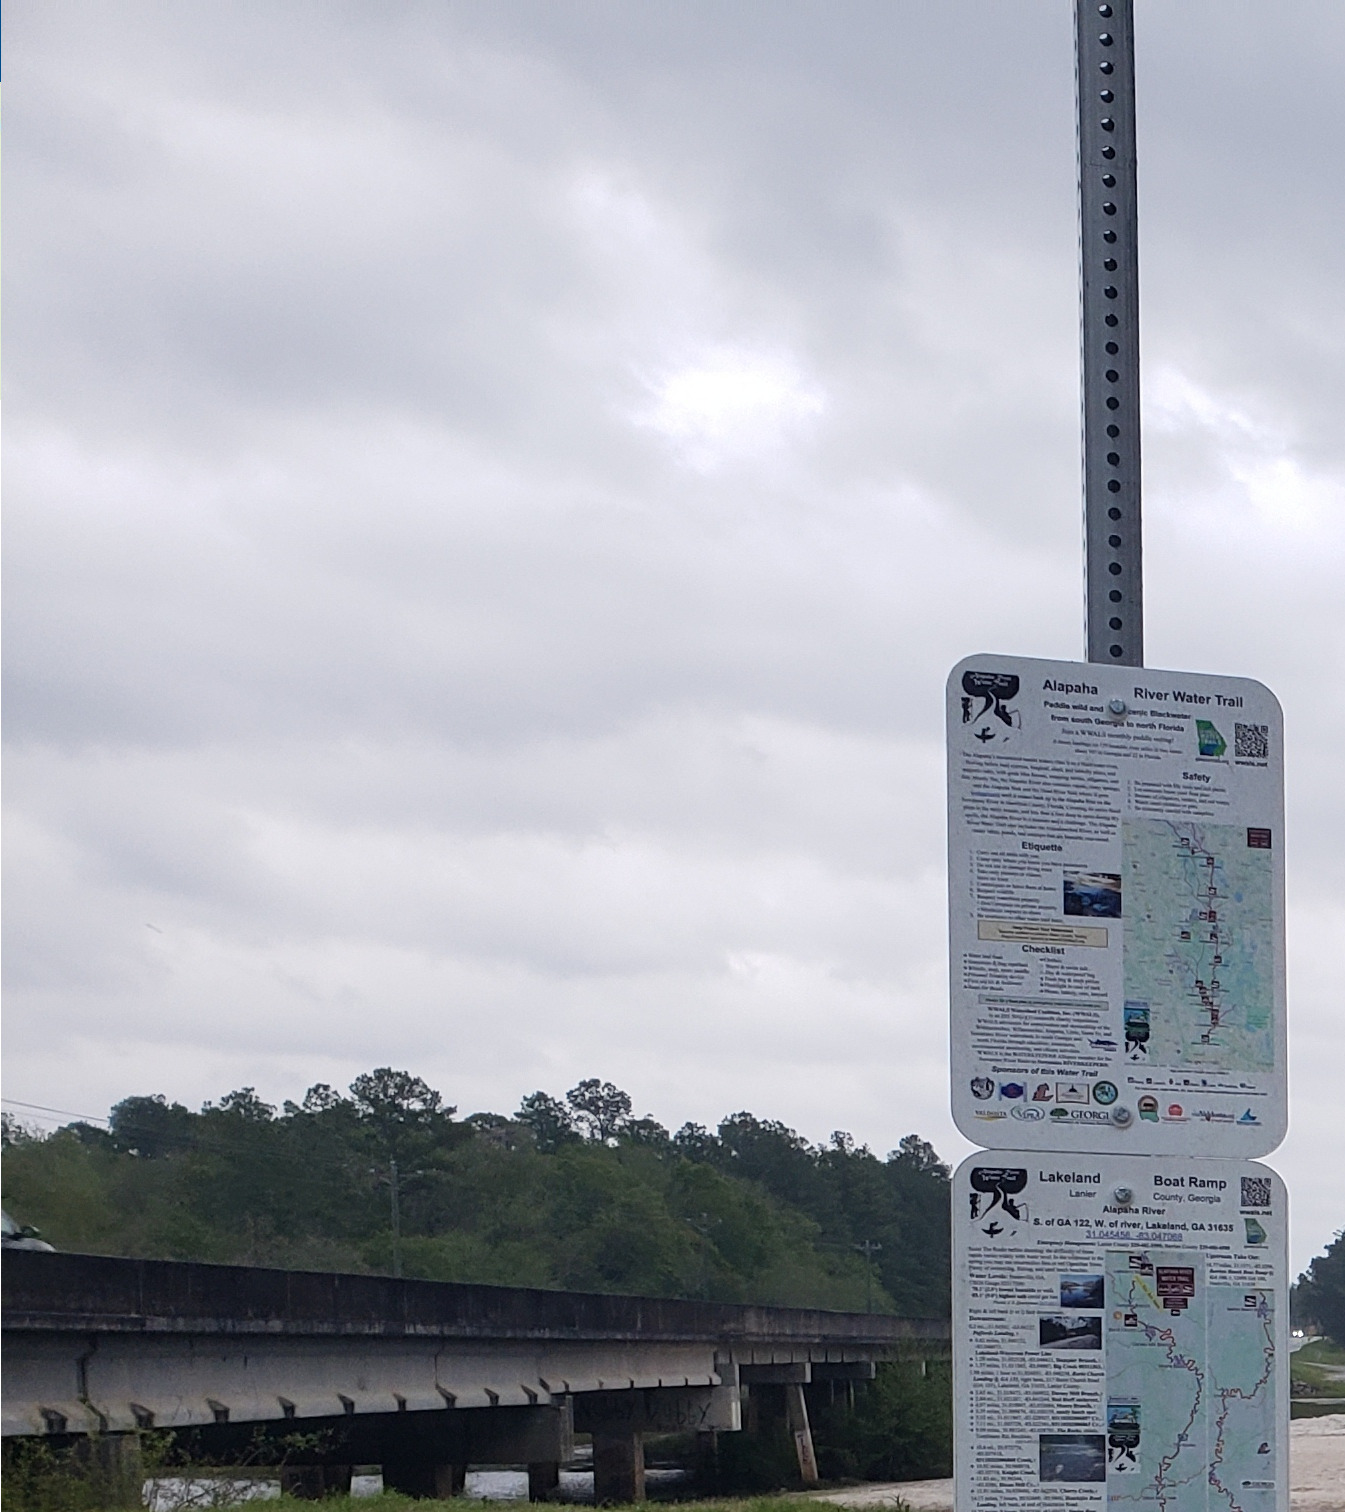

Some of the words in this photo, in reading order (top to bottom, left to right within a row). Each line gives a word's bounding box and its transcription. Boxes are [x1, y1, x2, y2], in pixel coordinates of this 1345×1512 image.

[1043, 679, 1098, 695] Alapaha
[1134, 687, 1169, 701] River
[1173, 690, 1211, 705] Water
[1215, 694, 1243, 708] Trail
[1043, 701, 1070, 710] Paddle
[1072, 702, 1088, 711] wild
[1090, 704, 1104, 712] and
[1150, 710, 1191, 720] Blackwater
[1051, 715, 1069, 723] from
[1071, 716, 1092, 724] south
[1094, 718, 1125, 729] Georgia
[1136, 722, 1156, 730] north
[1158, 723, 1185, 732] Florida
[1182, 772, 1211, 783] Safety
[1021, 841, 1063, 852] Etiquette
[1022, 945, 1066, 955] Checklist
[991, 1066, 1029, 1075] Sponsors
[1031, 1067, 1039, 1075] of
[1040, 1068, 1055, 1076] this
[1057, 1069, 1079, 1077] Water
[1081, 1070, 1099, 1078] Trail
[1070, 1110, 1109, 1120] GEORGI
[1039, 1171, 1101, 1184] Lakeland
[1154, 1175, 1185, 1187] Boat
[1189, 1176, 1227, 1191] Ramp
[1069, 1189, 1096, 1198] Lanier
[1153, 1192, 1185, 1203] County,
[1187, 1194, 1221, 1205] Georgia
[1103, 1205, 1140, 1216] Alapaha
[1142, 1206, 1166, 1216] River
[1033, 1218, 1042, 1226] S.
[1045, 1218, 1055, 1226] of
[1057, 1218, 1071, 1227] GA
[1074, 1219, 1092, 1228] 122,
[1094, 1220, 1106, 1229] W.
[1109, 1220, 1119, 1229] of
[1120, 1221, 1144, 1231] river,
[1146, 1222, 1189, 1232] Lakeland,
[1191, 1223, 1206, 1232] GA
